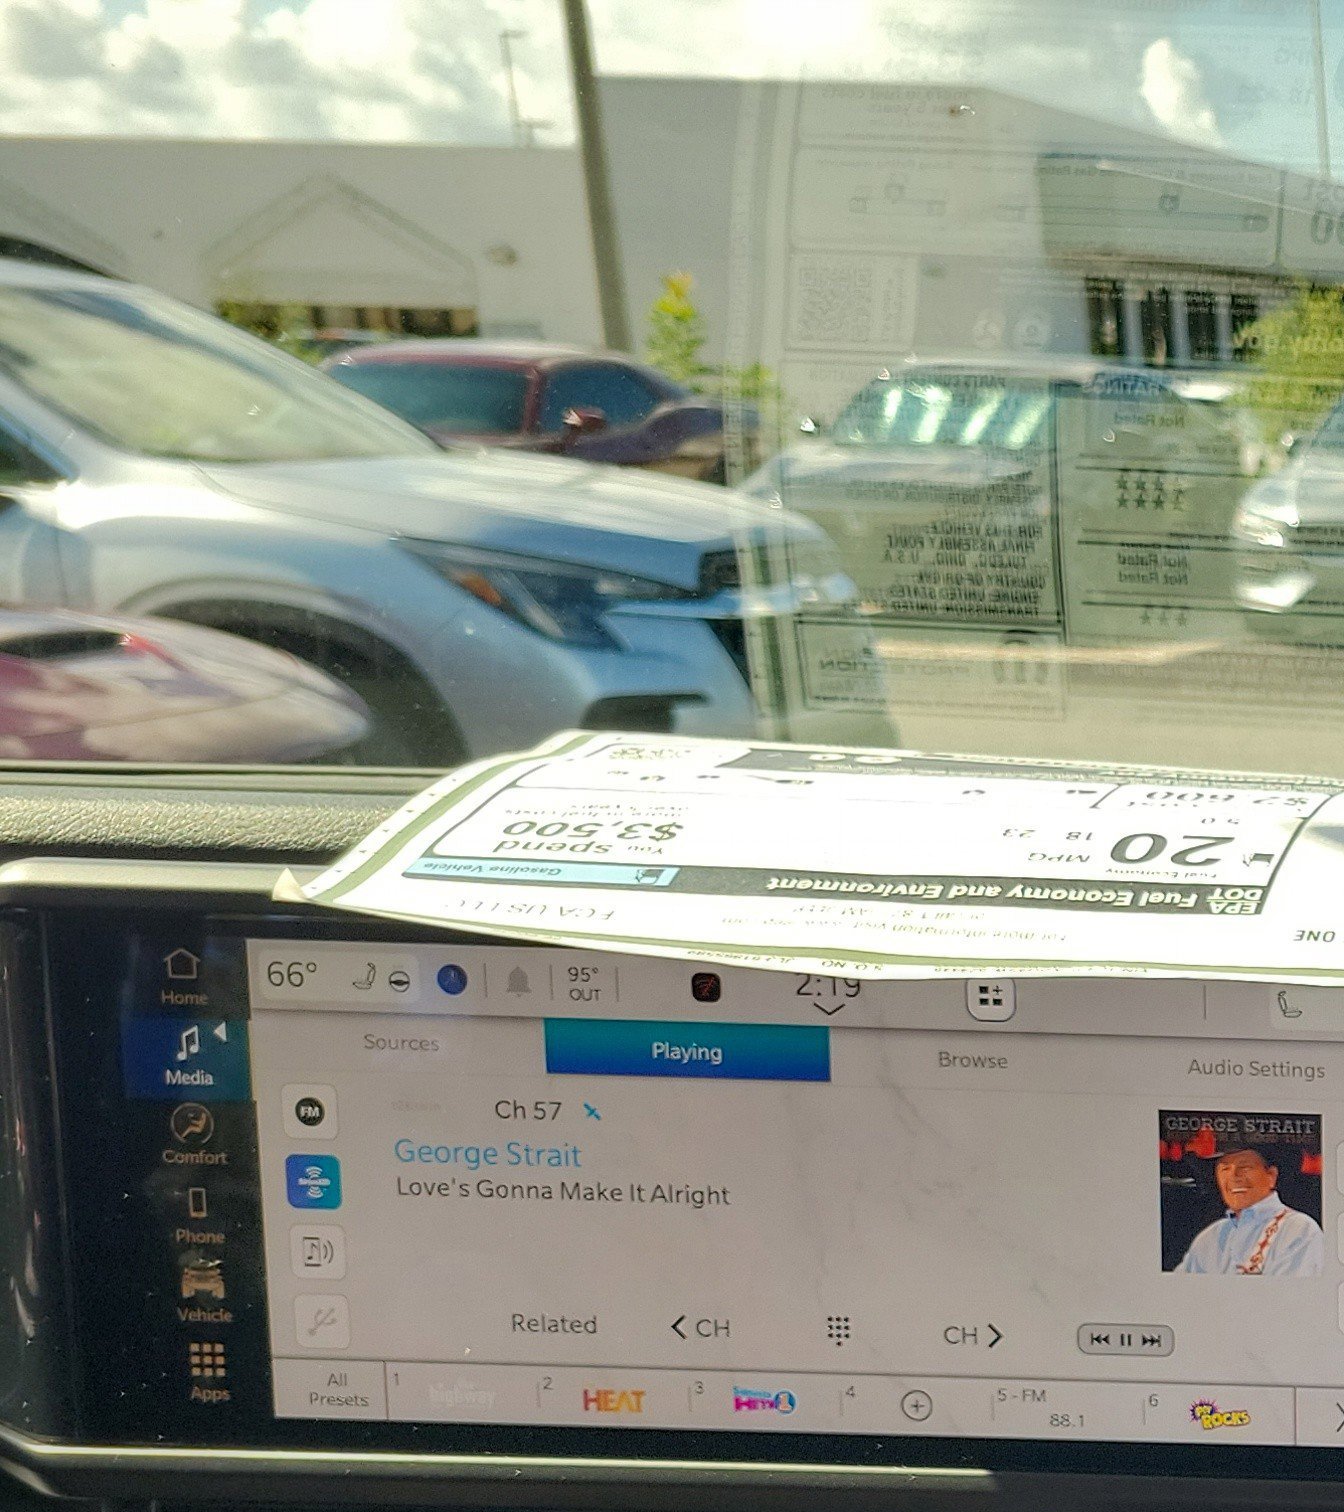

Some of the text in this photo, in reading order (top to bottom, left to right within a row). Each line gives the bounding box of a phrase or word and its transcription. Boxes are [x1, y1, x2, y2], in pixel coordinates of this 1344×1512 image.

[502, 820, 685, 842] $3,500
[1065, 830, 1093, 841] 18
[492, 840, 614, 855] spend
[1110, 832, 1236, 867] 20
[423, 862, 563, 876] Gasoline Vehicle
[765, 876, 1199, 908] Fuel Economy and Environment
[1206, 887, 1264, 901] DOT
[1208, 902, 1258, 914] EPA
[1292, 929, 1336, 943] ONE
[267, 961, 317, 987] 66°
[567, 966, 599, 983] 95°
[569, 988, 602, 1001] OUT
[797, 974, 860, 998] 2:19
[161, 989, 210, 1006] Home
[363, 1034, 440, 1052] Sources
[650, 1041, 723, 1065] Playing
[938, 1050, 1009, 1069] Browse
[165, 1069, 214, 1086] Media
[1188, 1059, 1325, 1082] Audio Settings
[298, 1104, 322, 1119] FM
[495, 1100, 562, 1121] Ch 57
[1165, 1116, 1316, 1136] GEORGE STRAIT
[162, 1149, 227, 1165] Comfort
[394, 1139, 583, 1171] George Strait
[396, 1177, 732, 1209] Love's Gonna Make It Alright
[174, 1228, 225, 1243] Phone
[177, 1307, 233, 1323] Vehicle
[512, 1313, 598, 1335] Related
[696, 1319, 731, 1338] CH
[943, 1326, 978, 1345] CH
[327, 1371, 348, 1386] All
[542, 1376, 554, 1390] 2
[191, 1386, 231, 1404] Apps
[695, 1381, 705, 1395] 3
[845, 1385, 856, 1398] 4
[309, 1391, 369, 1407] Presets
[582, 1388, 646, 1413] HEAT
[1148, 1393, 1159, 1407] 6
[1048, 1413, 1085, 1427] 88.1
